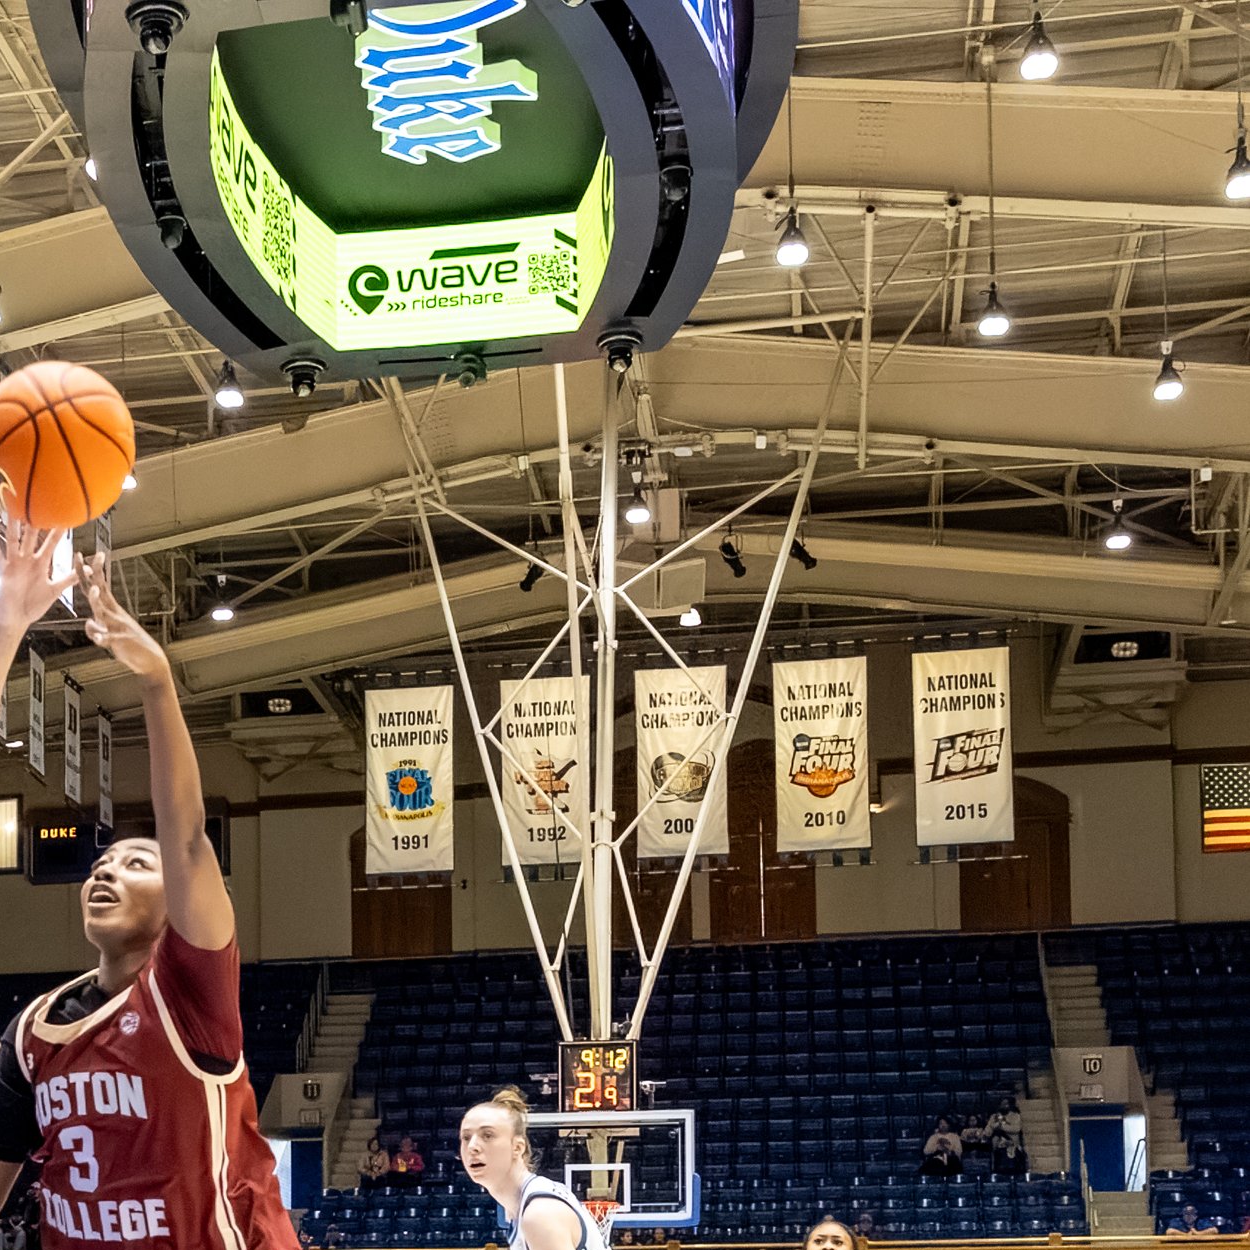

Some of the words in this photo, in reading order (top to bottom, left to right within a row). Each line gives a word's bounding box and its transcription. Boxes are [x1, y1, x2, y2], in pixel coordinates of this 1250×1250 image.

[397, 259, 518, 292] wave
[412, 292, 504, 310] rideshare
[787, 681, 854, 701] NATIONAL
[927, 672, 997, 692] NATIONAL
[780, 701, 863, 723] CHAMPIONS
[919, 692, 1006, 714] CHAMPIONS
[377, 710, 442, 728] NATIONAL
[506, 719, 577, 738] CHAMPION
[371, 728, 449, 749] CHAMPIONS
[809, 738, 853, 755] FINAL
[954, 733, 1001, 753] FINAL
[399, 760, 417, 768] 1991
[791, 752, 854, 775] FOUR
[804, 810, 846, 828] 2010
[945, 803, 988, 820] 2015
[40, 827, 77, 839] DUKE
[527, 826, 567, 842] 1992
[663, 818, 697, 835] 200
[392, 834, 430, 851] 1991
[581, 1048, 627, 1070] 9:12
[1085, 1059, 1100, 1072] 10
[574, 1072, 618, 1109] 2.9
[35, 1071, 148, 1132] OSTON
[58, 1125, 99, 1193] 3
